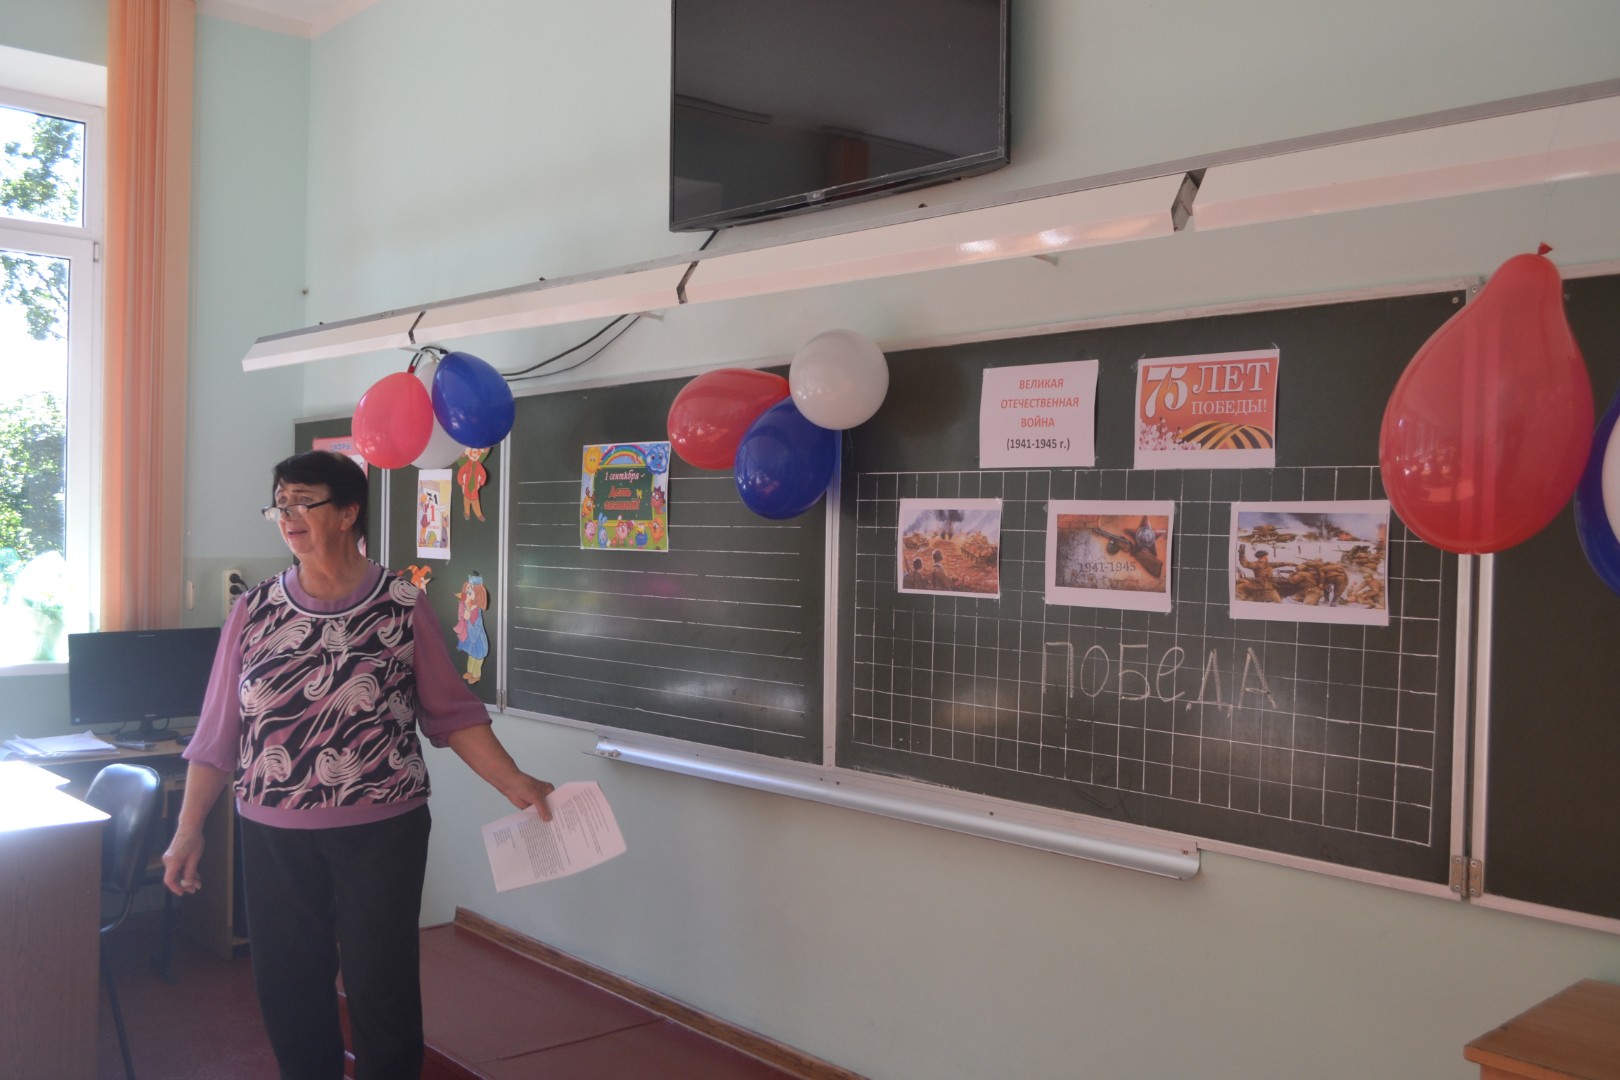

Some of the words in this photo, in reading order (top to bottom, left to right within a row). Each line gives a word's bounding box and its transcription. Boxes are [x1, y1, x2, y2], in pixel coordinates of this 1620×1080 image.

[1019, 378, 1064, 390] ВЕЛИКАЯ
[1145, 365, 1188, 418] 75
[1191, 361, 1270, 394] ЛЕТ
[1000, 397, 1079, 409] ОТЕЧЕСТВЕННАЯ
[1191, 398, 1267, 416] ПОБЕДЫ!
[1021, 415, 1055, 428] ВОЙНА
[1006, 438, 1057, 451] (1941-1945
[1059, 438, 1070, 451] г.)
[1079, 561, 1136, 573] 1941-1945
